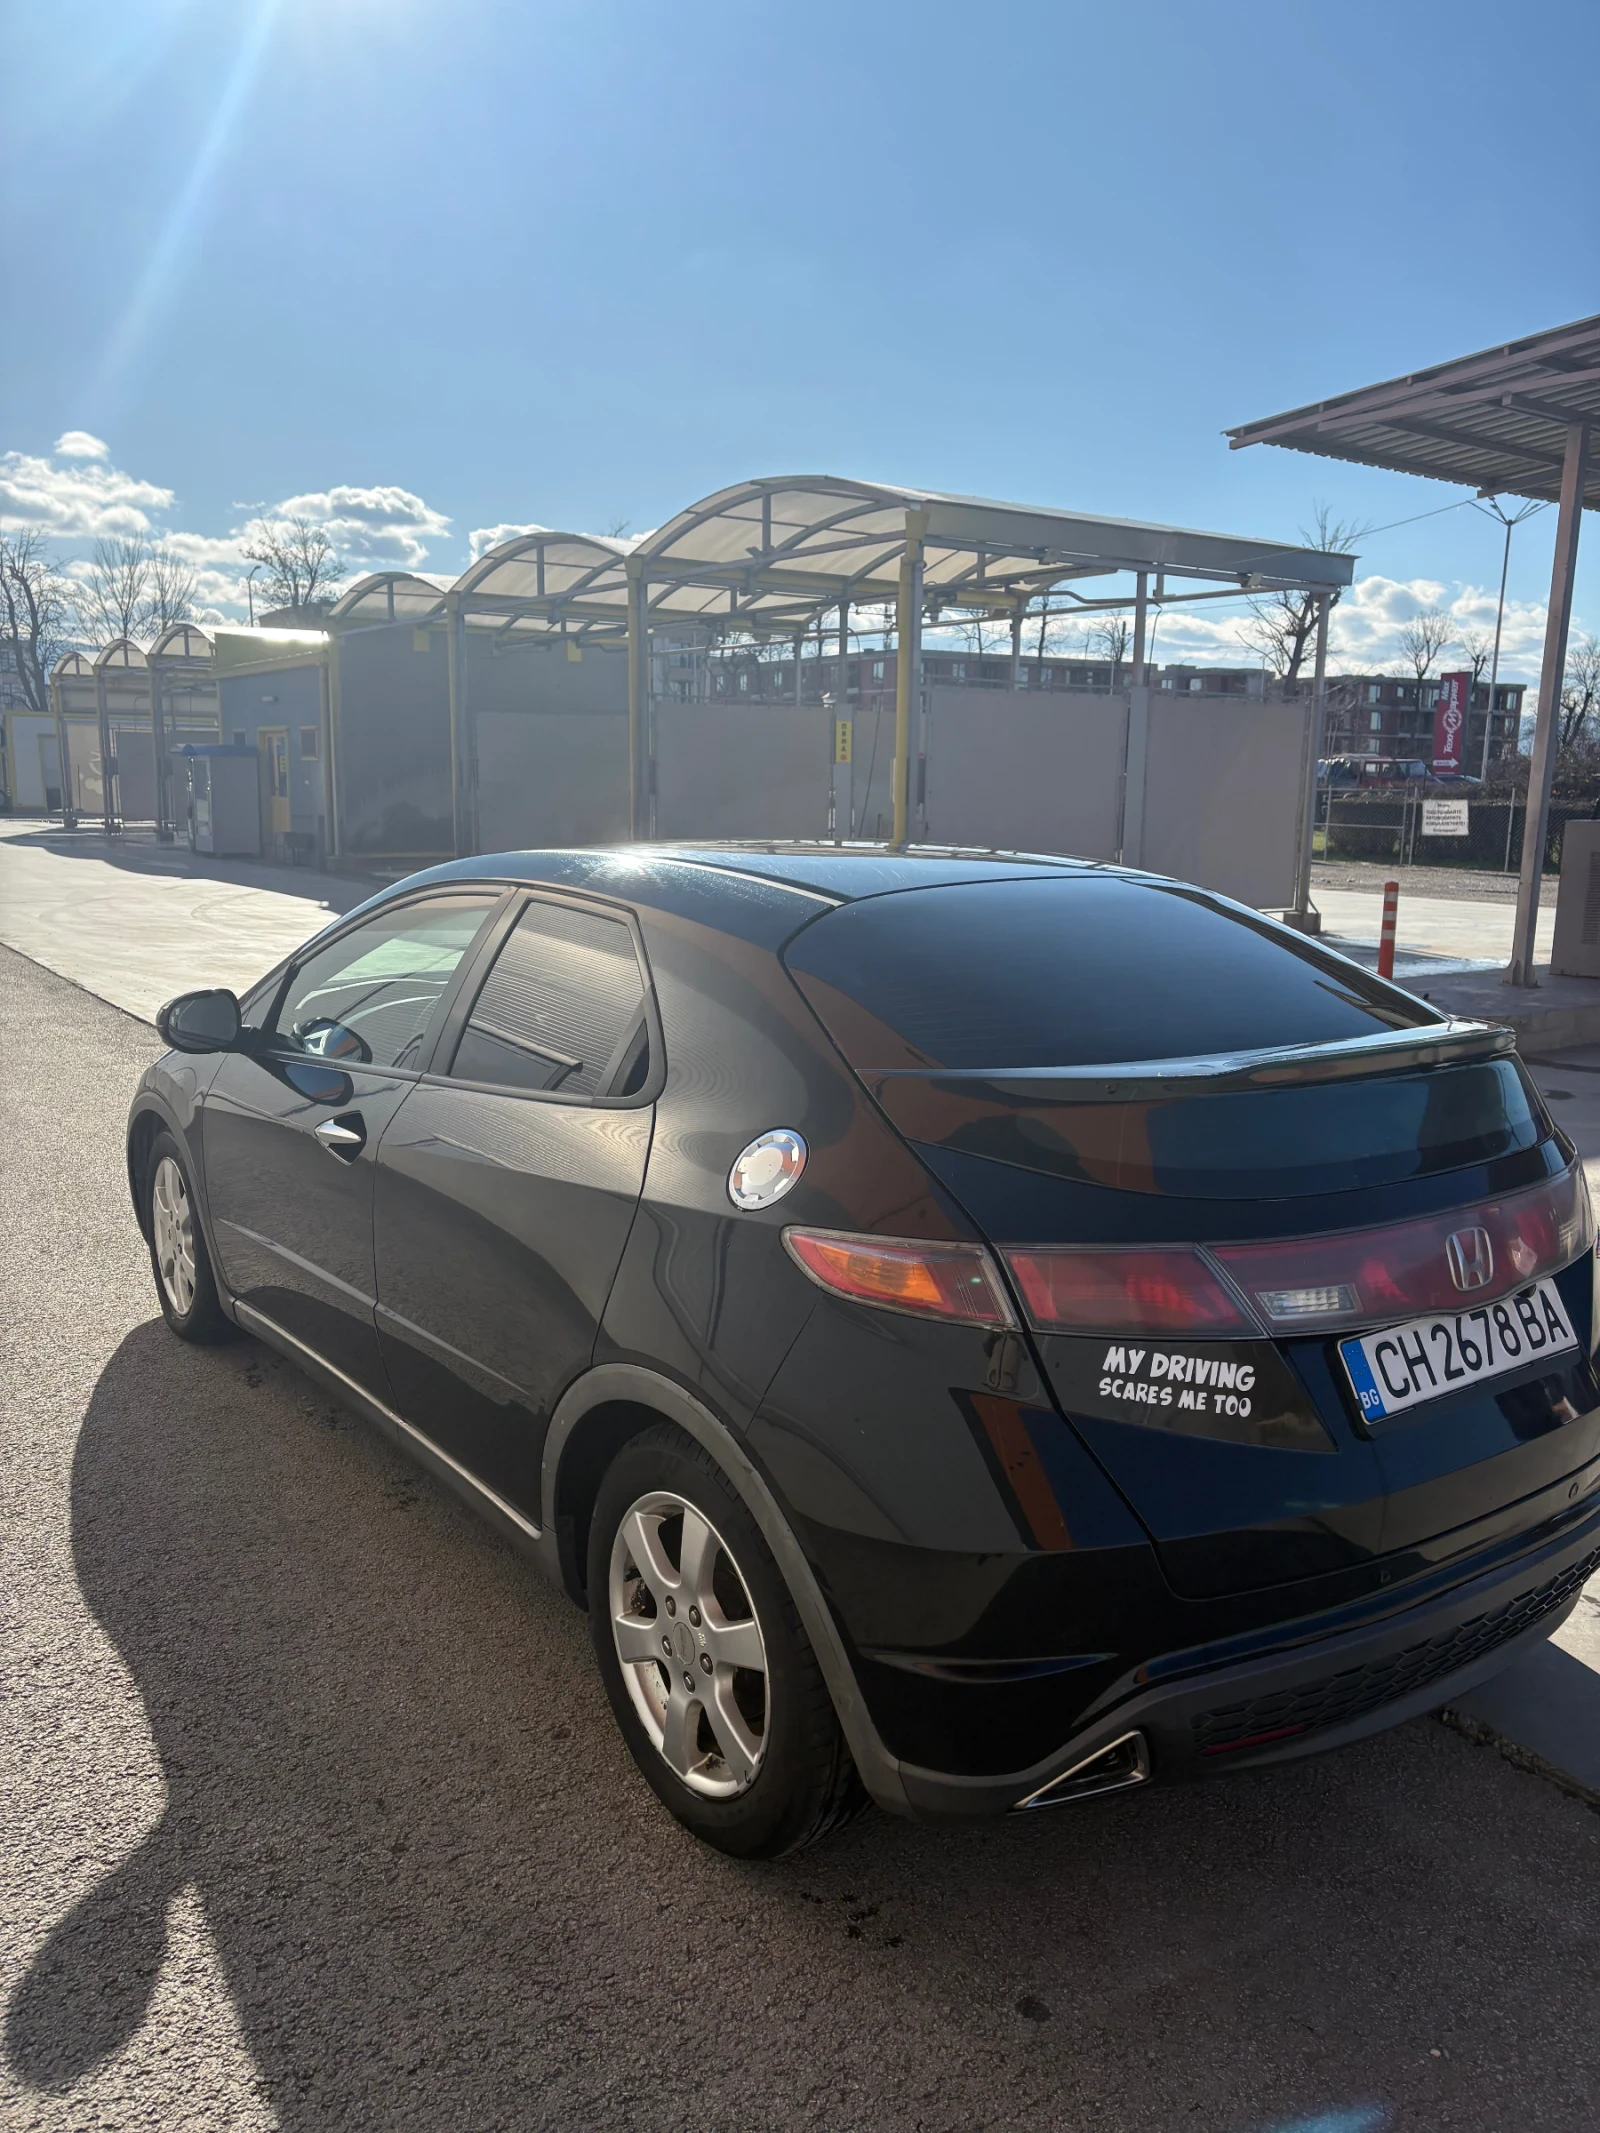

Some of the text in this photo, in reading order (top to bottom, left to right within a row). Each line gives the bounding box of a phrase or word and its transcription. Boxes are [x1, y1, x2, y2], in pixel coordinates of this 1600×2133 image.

[1102, 1345, 1256, 1392] MY DRIVING
[1098, 1377, 1252, 1418] SCARES ME TOO
[1360, 1389, 1380, 1410] BG
